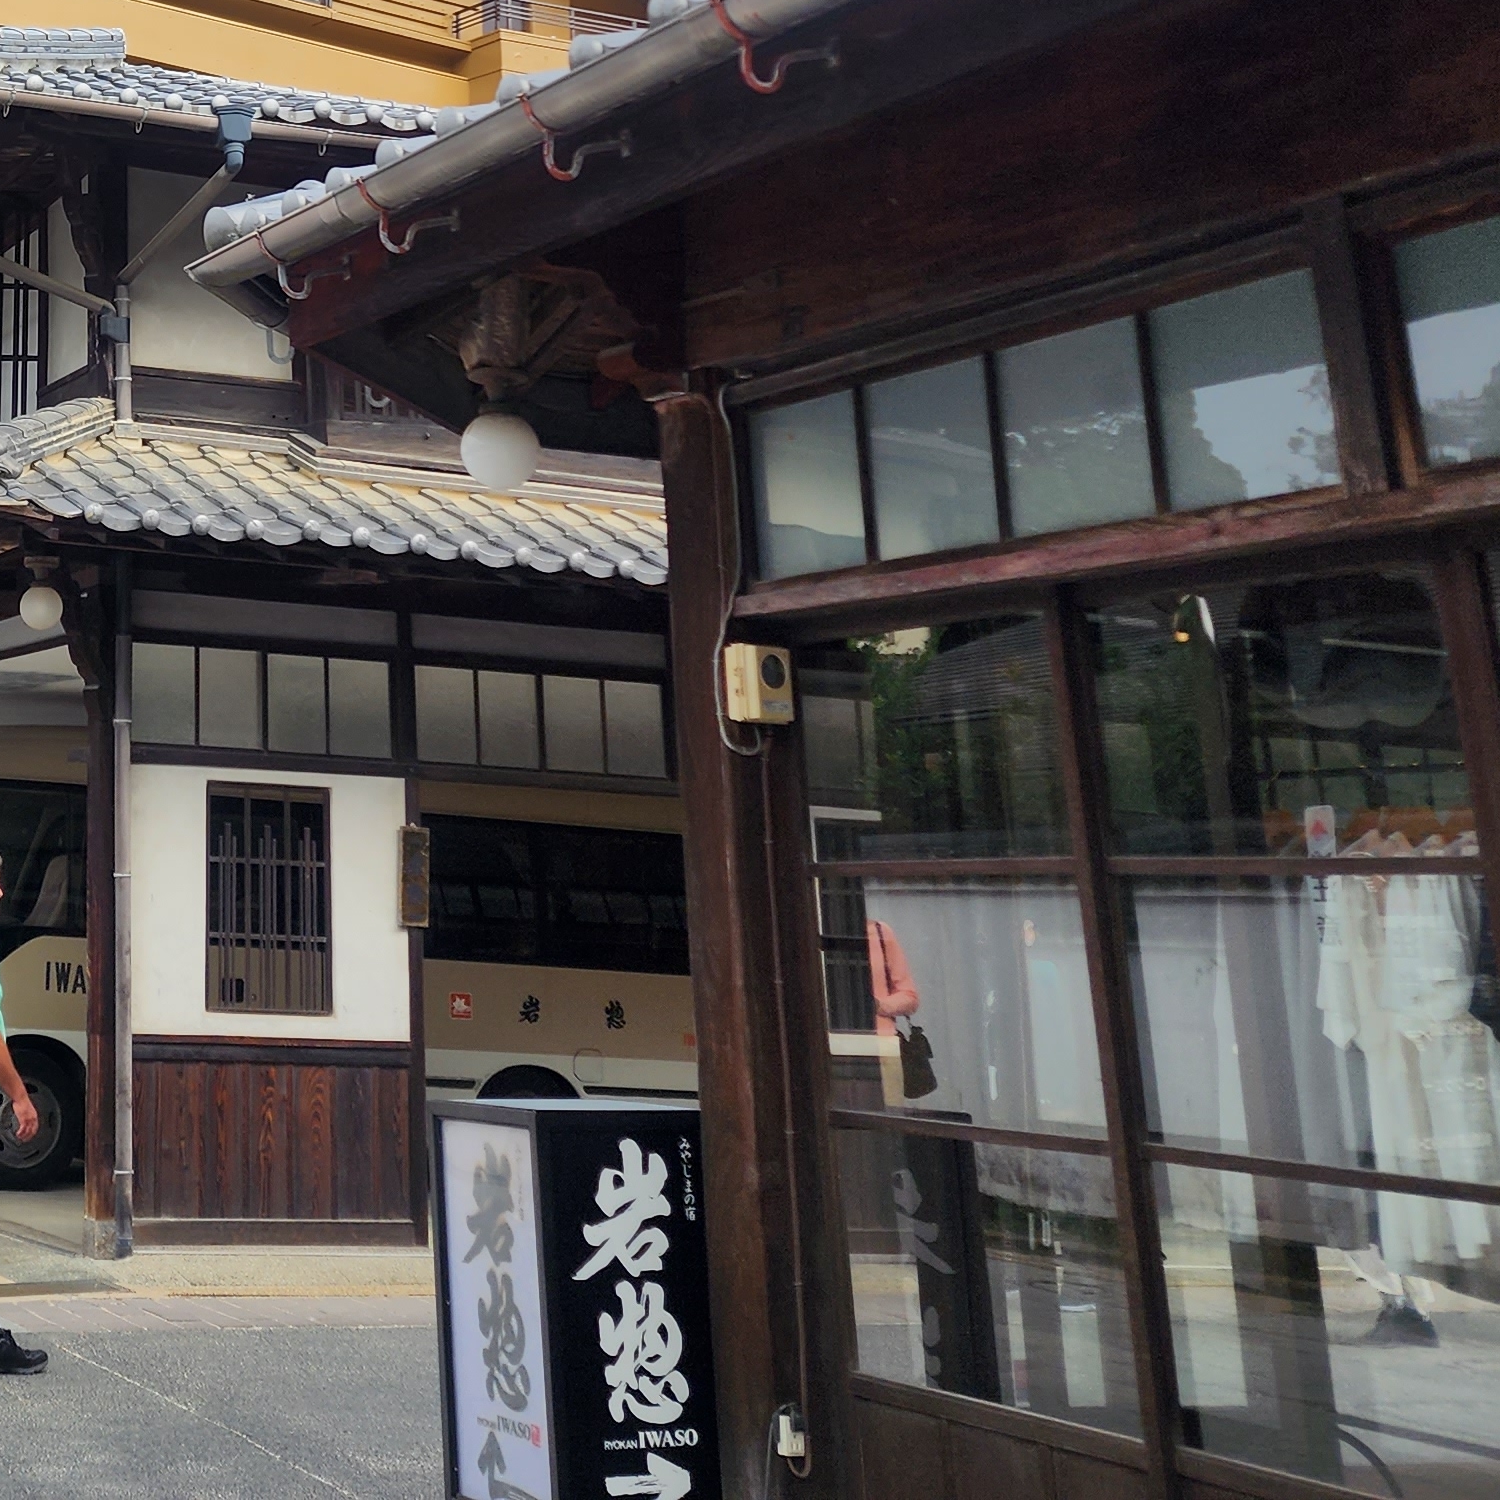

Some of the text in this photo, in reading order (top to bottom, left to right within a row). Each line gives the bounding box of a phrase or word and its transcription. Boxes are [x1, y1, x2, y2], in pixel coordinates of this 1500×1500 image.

[45, 961, 87, 994] IWA
[679, 1135, 697, 1221] みやじまの宿
[571, 1137, 691, 1425] 岩惣
[603, 1428, 699, 1451] RYOKAN IWASO
